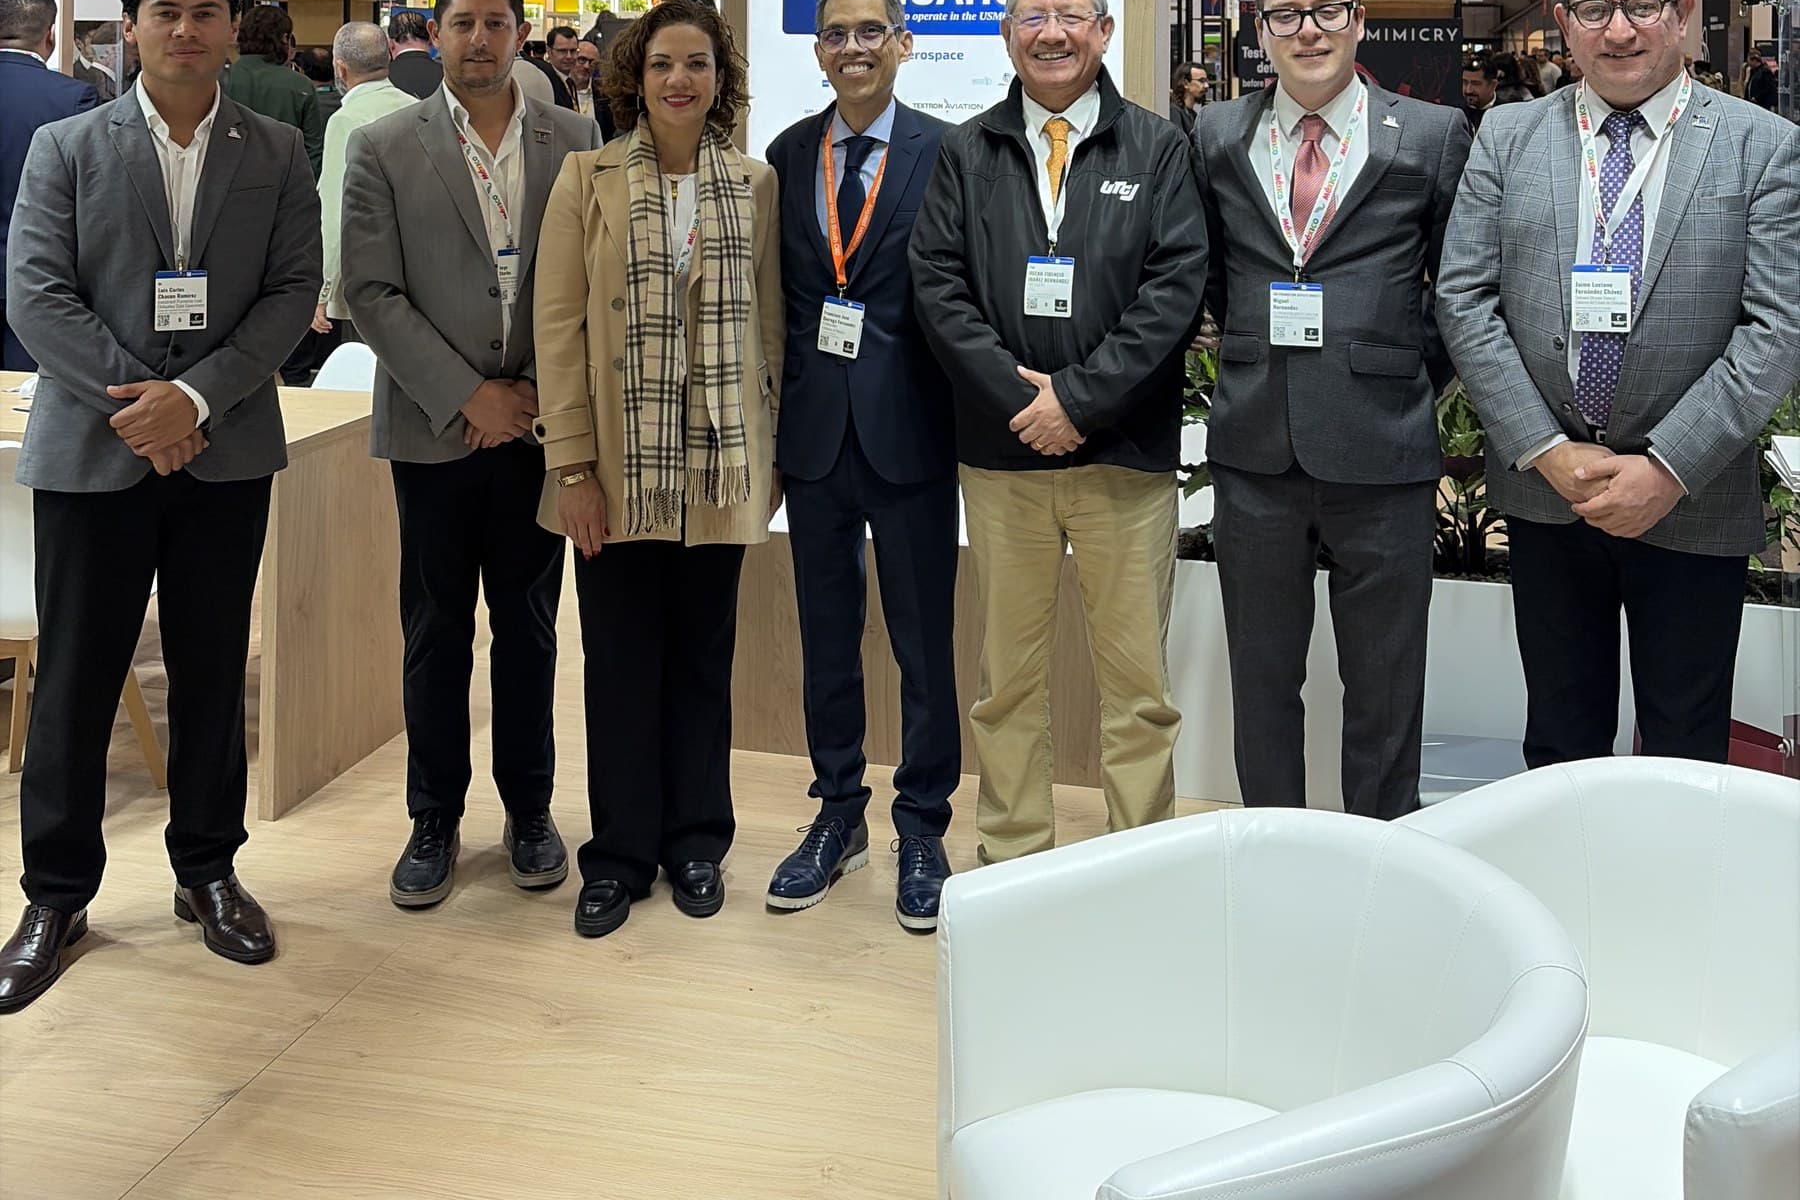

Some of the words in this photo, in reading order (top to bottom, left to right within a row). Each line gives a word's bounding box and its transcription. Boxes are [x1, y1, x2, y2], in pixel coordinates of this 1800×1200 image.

[912, 12, 948, 23] operate
[950, 11, 960, 21] in
[962, 11, 977, 21] the
[1366, 28, 1459, 42] MIMICRY
[909, 50, 965, 62] erospace
[1242, 46, 1265, 59] Test
[1242, 78, 1264, 88] before
[944, 101, 984, 110] AVIATION
